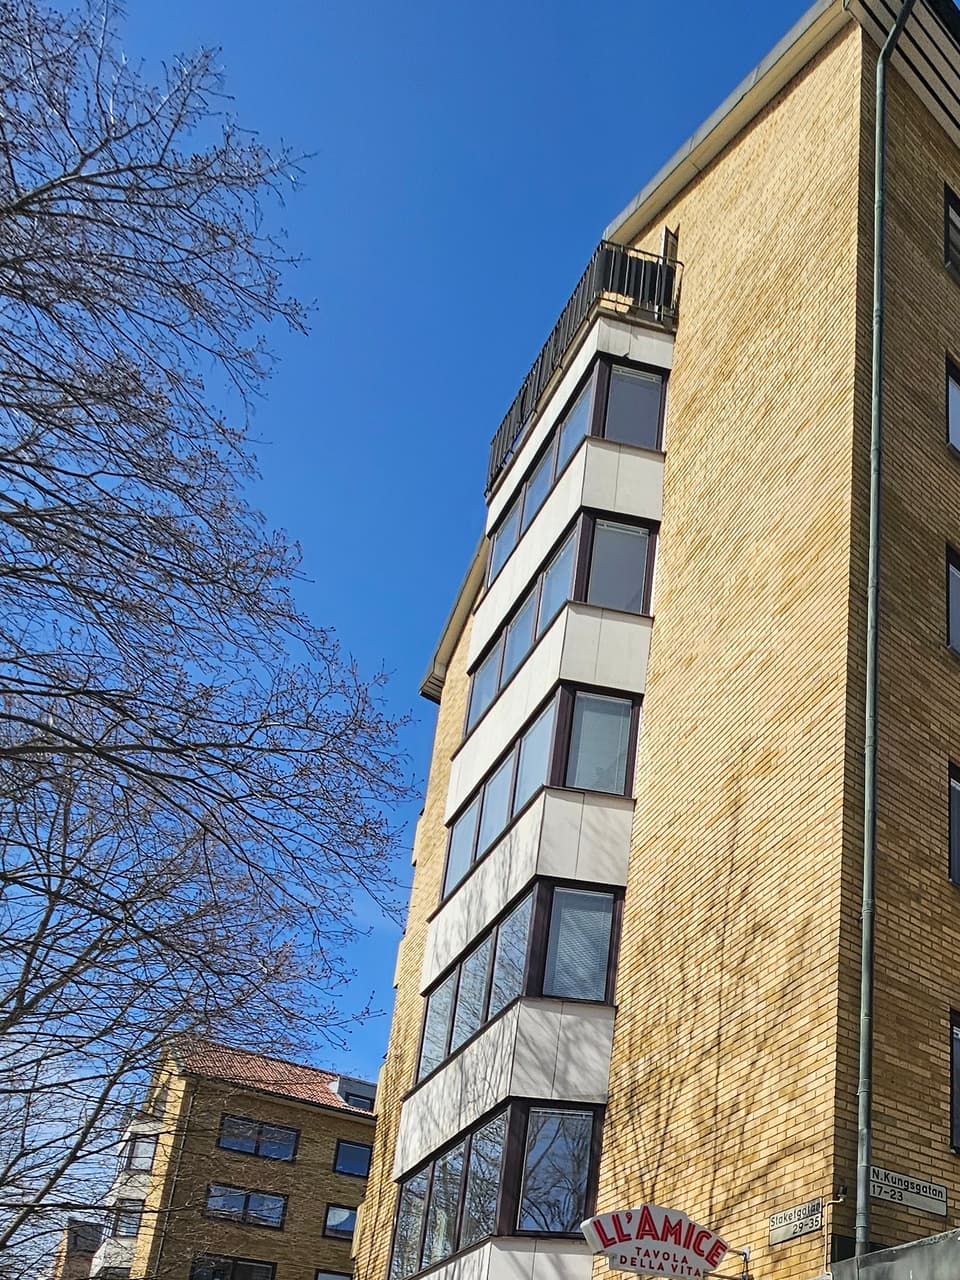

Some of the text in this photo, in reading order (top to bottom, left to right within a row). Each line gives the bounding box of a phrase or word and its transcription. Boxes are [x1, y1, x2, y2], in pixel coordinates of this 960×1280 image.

[872, 1184, 904, 1202] 17-23
[792, 1216, 820, 1235] 29-35
[635, 1246, 688, 1264] TAVOLA
[620, 1255, 701, 1277] DELLA VITA
